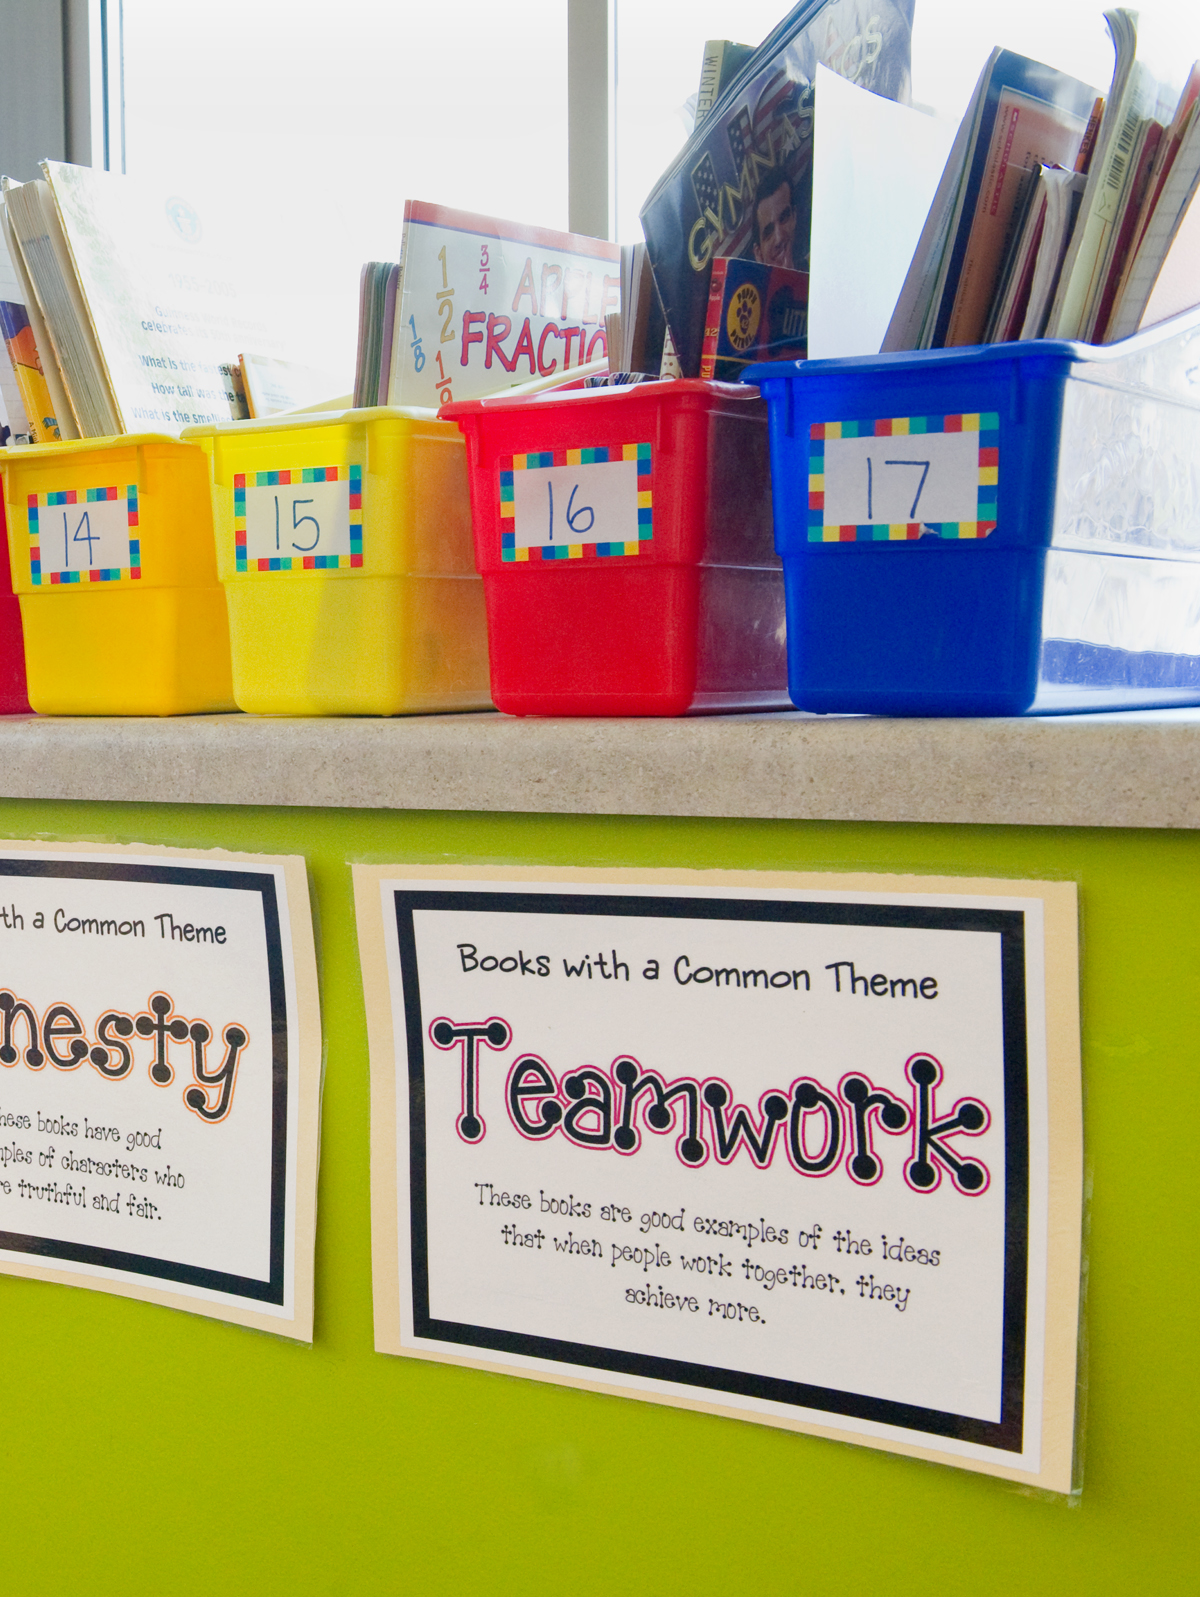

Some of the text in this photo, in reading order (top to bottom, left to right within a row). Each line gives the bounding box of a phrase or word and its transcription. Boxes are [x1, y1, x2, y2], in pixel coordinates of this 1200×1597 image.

[696, 54, 718, 121] WINTER
[688, 15, 882, 271] GYMNASCS
[982, 106, 1010, 212] www.scholastic.com
[141, 320, 192, 336] celebrates
[461, 310, 608, 377] FRACTIO
[139, 354, 167, 369] What
[169, 357, 178, 370] is
[180, 360, 196, 372] the
[151, 382, 175, 395] How
[178, 385, 194, 398] tall
[196, 388, 216, 399] was
[219, 390, 234, 401] the
[131, 407, 190, 423] What is the
[546, 480, 595, 541] 16
[865, 456, 930, 521] 17
[63, 511, 101, 567] 14
[273, 495, 321, 552] 15
[32, 912, 45, 930] a
[53, 908, 145, 938] Common
[154, 913, 227, 945] Theme
[457, 943, 939, 1000] Books with a Common Theme
[37, 1111, 79, 1137] books
[84, 1118, 121, 1142] have
[126, 1128, 162, 1151] good
[429, 1016, 991, 1196] Teamwork
[38, 1146, 55, 1168] of
[61, 1150, 148, 1182] characters
[155, 1165, 185, 1189] who
[18, 1179, 86, 1208] truthful
[92, 1193, 120, 1214] and
[126, 1193, 162, 1220] fair.
[474, 1183, 941, 1266] These books are good examples of the ideas
[501, 1224, 911, 1312] that when people work together, they
[625, 1283, 766, 1324] achieve more.
